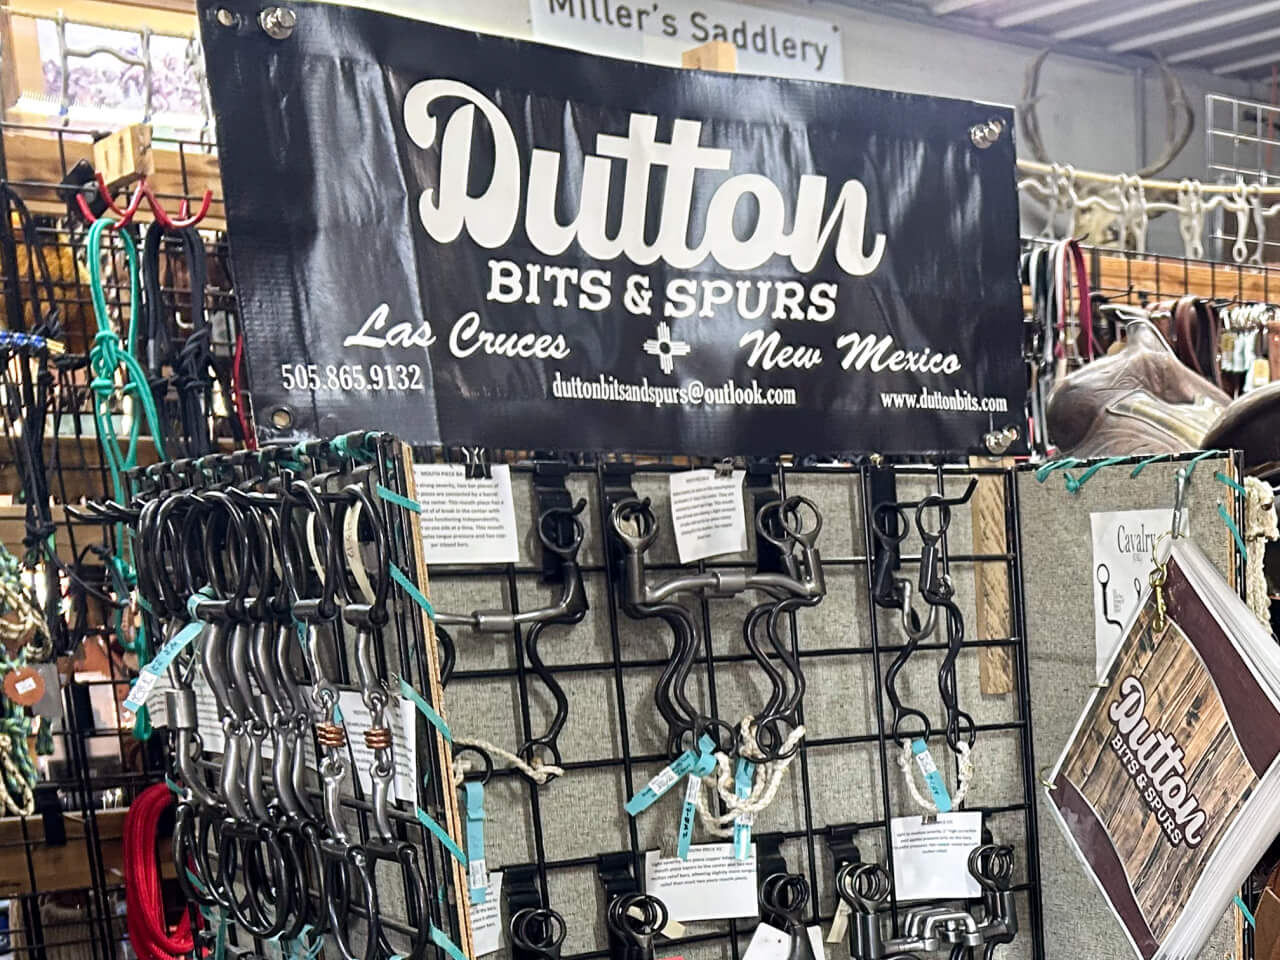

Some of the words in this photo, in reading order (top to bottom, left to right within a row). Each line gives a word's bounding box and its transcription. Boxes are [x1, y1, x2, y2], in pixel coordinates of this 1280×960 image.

[690, 11, 829, 72] Saddlery
[403, 78, 887, 275] Dutton
[487, 258, 612, 312] BITS
[623, 274, 653, 316] &
[663, 278, 839, 323] SPURS
[343, 303, 437, 349] Las
[448, 311, 571, 360] Cruces
[738, 328, 823, 371] New
[836, 333, 962, 375] Mexico
[281, 363, 424, 392] 505.865.9132
[552, 371, 797, 408] duttonbitsandspurs@outlook.com
[880, 388, 1008, 413] www.duttonbits.com
[1117, 523, 1156, 562] Cavalry
[1110, 676, 1206, 846] Dutton
[1111, 733, 1140, 775] BITS
[1136, 773, 1148, 789] &
[1144, 786, 1182, 844] SPURS
